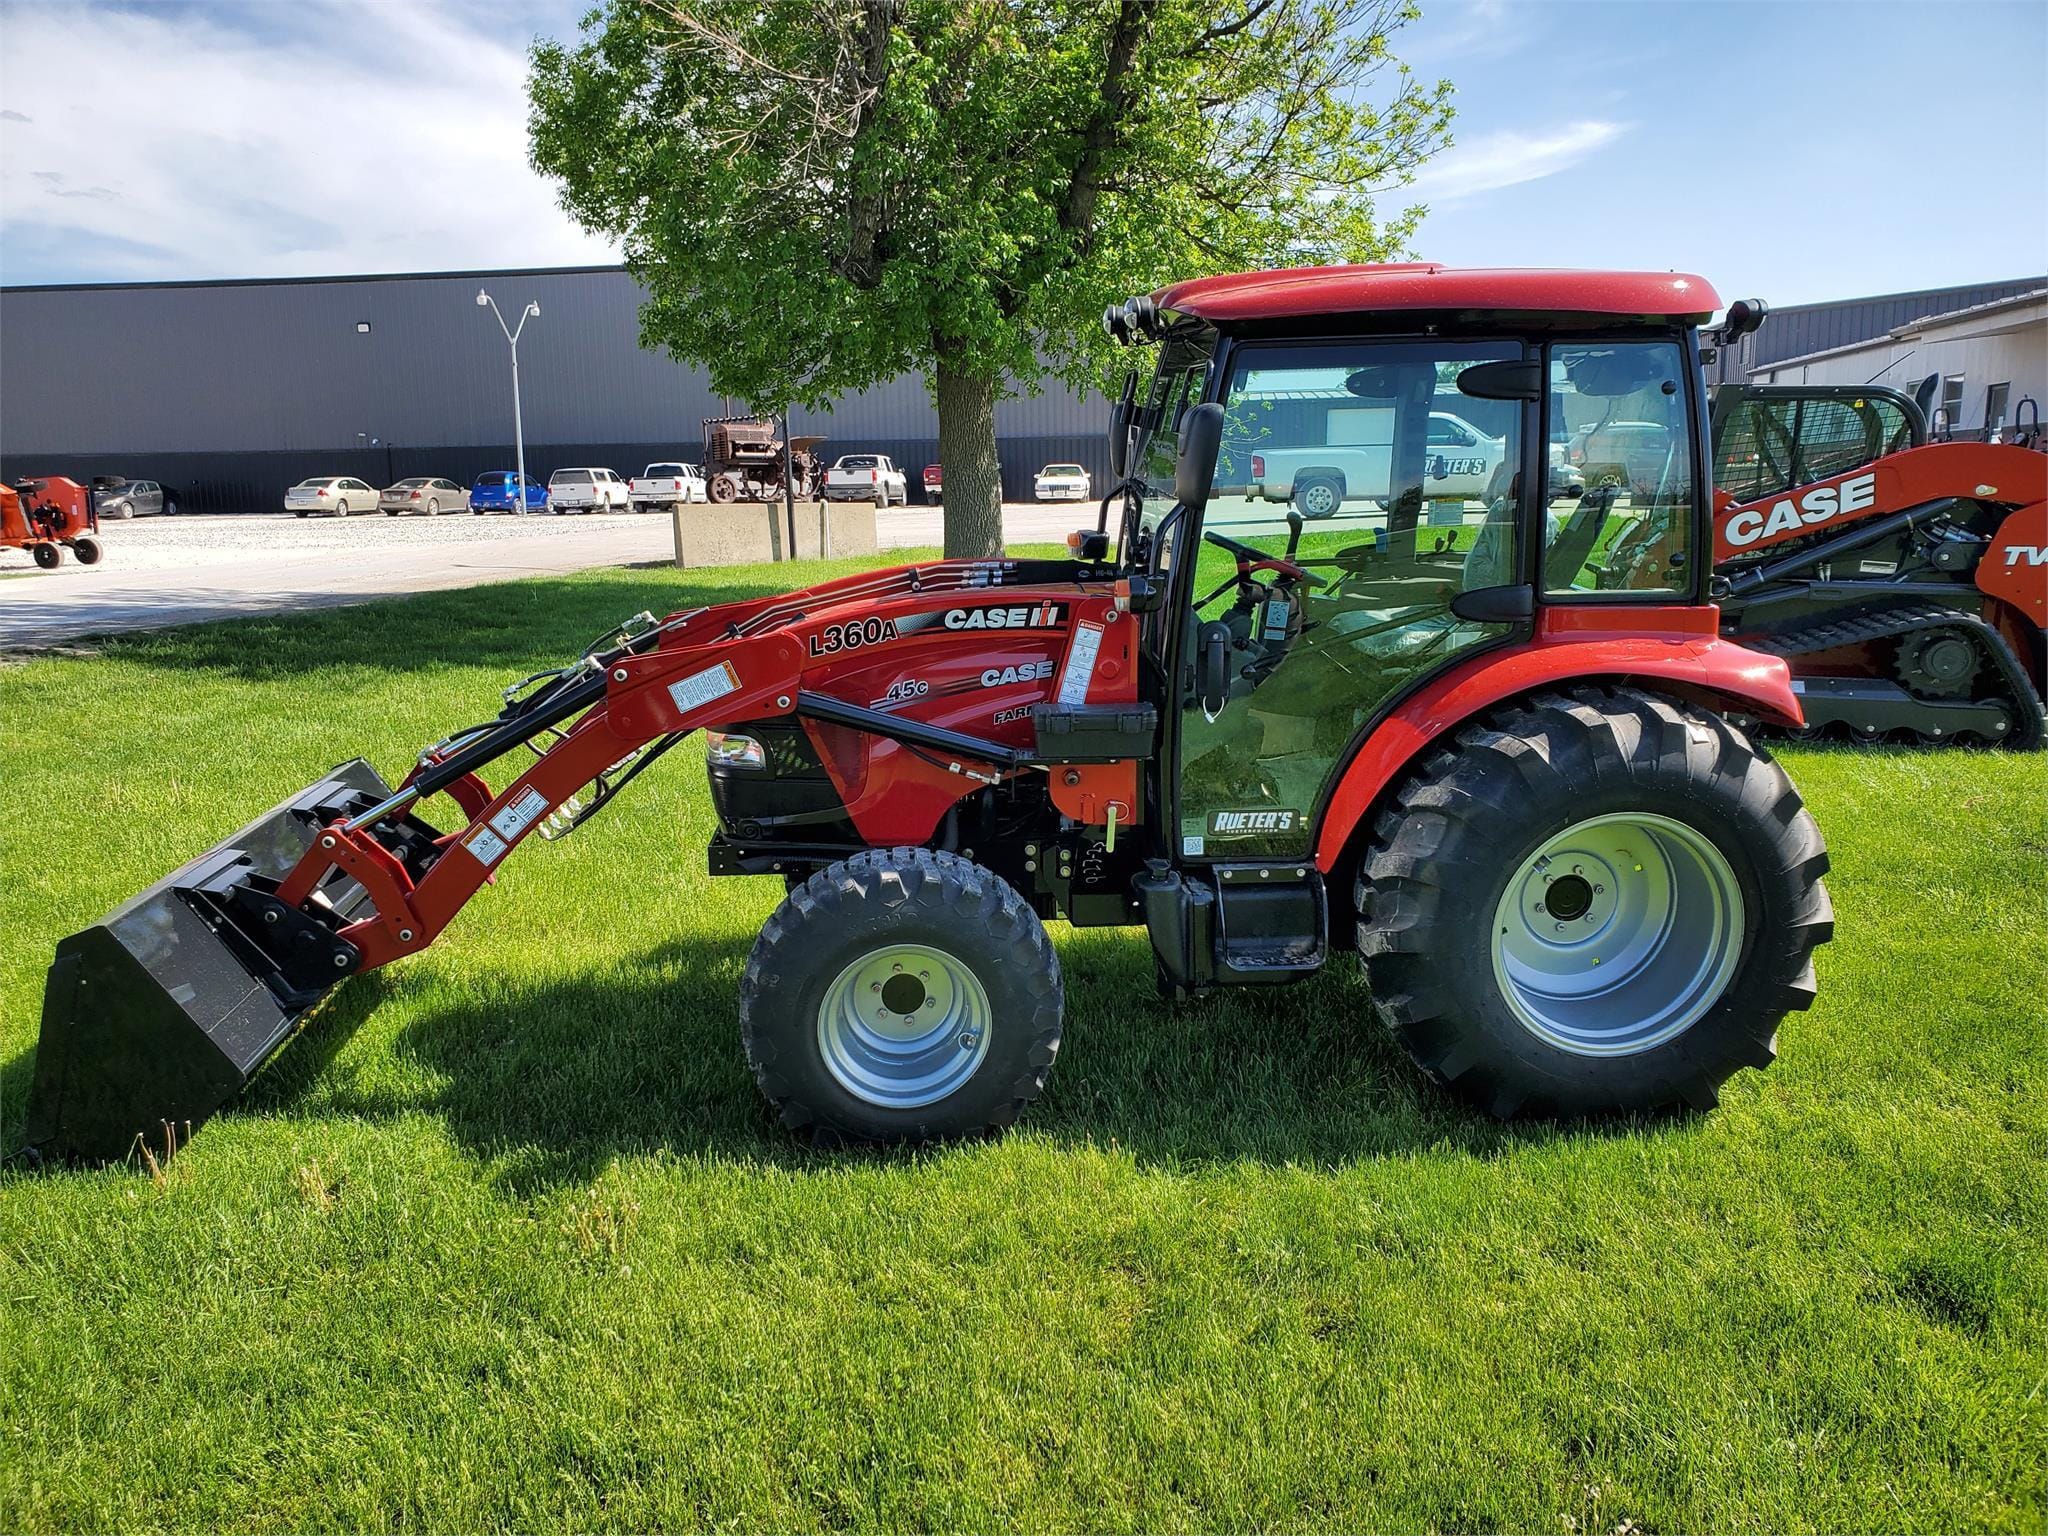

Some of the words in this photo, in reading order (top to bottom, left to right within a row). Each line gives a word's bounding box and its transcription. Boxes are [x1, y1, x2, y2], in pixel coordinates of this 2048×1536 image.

[1725, 472, 1875, 546] CASE
[944, 608, 1029, 629] CASE
[809, 616, 898, 657] L360A
[980, 661, 1053, 687] CASE
[1214, 811, 1293, 832] RUETER'S
